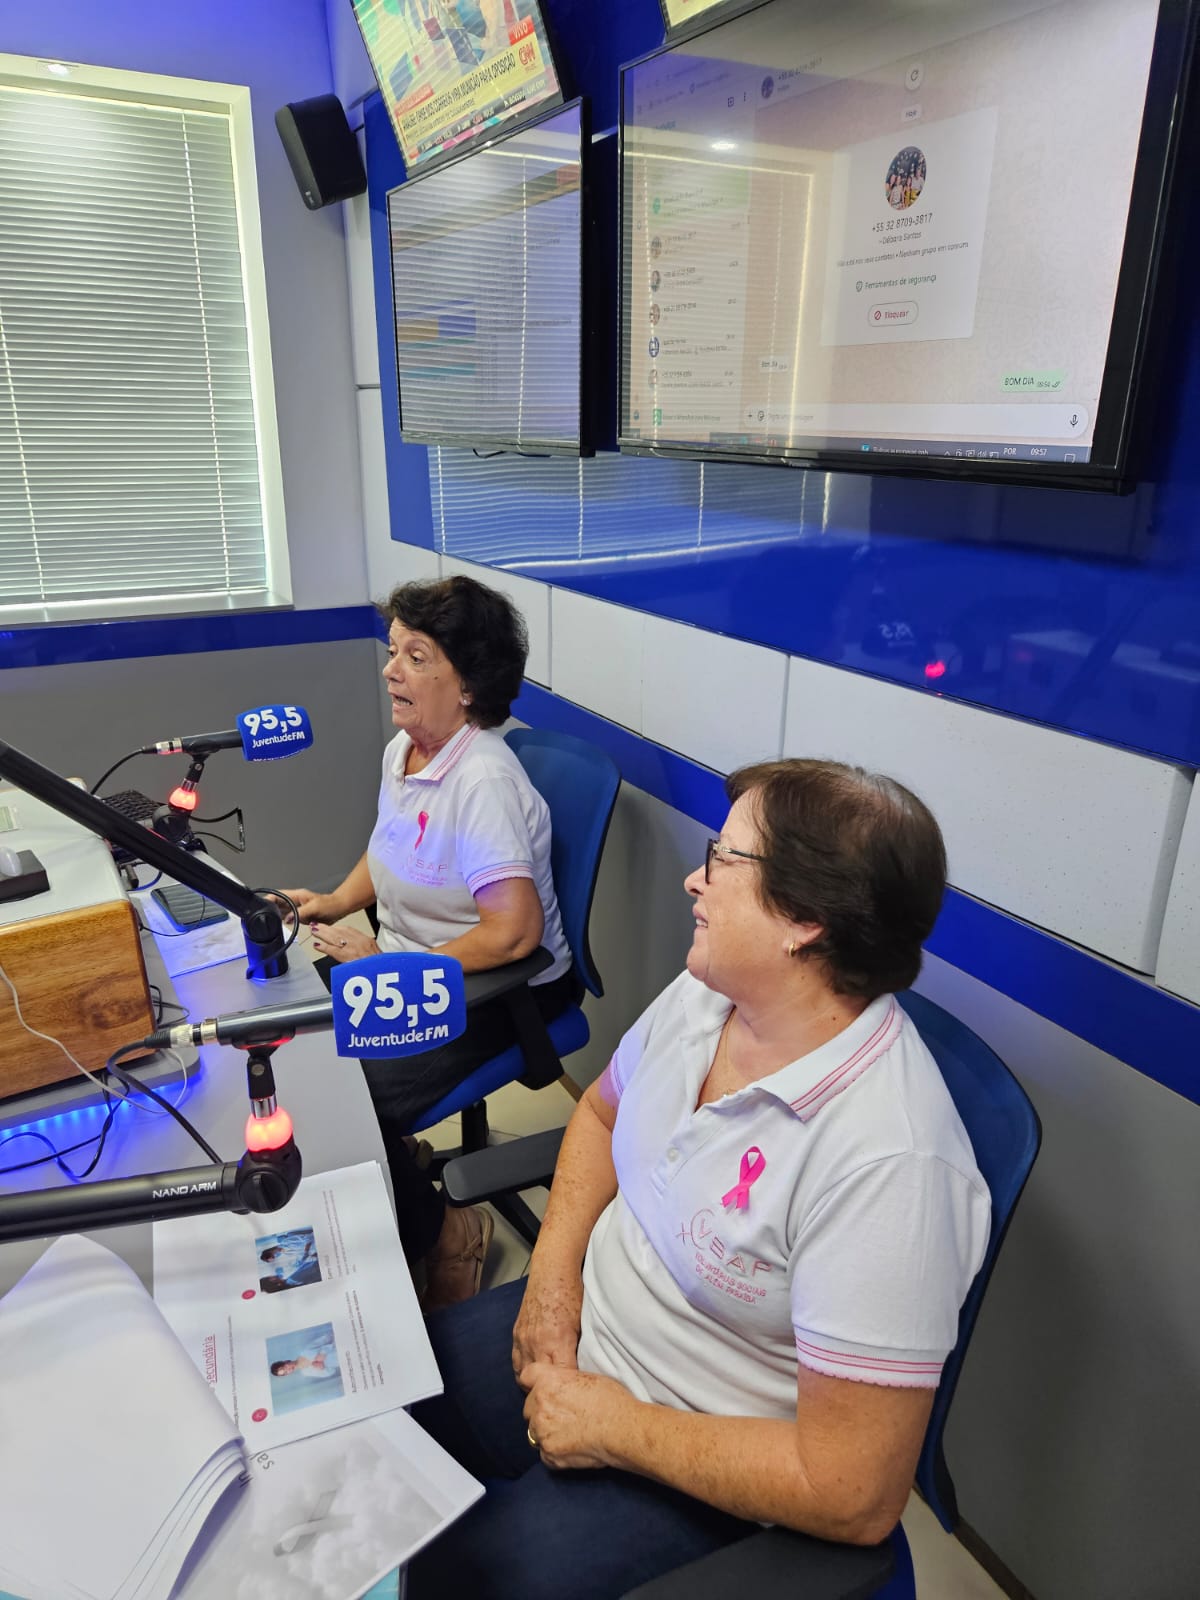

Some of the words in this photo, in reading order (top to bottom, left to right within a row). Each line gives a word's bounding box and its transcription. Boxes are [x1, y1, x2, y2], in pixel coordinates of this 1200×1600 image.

[513, 24, 528, 39] VIVO
[490, 50, 516, 80] OPOSIÇÃO
[872, 222, 884, 233] +55
[886, 221, 894, 231] 32
[896, 213, 933, 228] 8709-3817
[1004, 377, 1021, 386] BOM
[1022, 377, 1034, 385] DIA
[1003, 447, 1017, 456] POR
[1030, 447, 1048, 457] 09:57
[243, 706, 303, 737] 95,5
[343, 968, 451, 1029] 95,5
[152, 1185, 189, 1199] NANO
[190, 1181, 217, 1193] ARM
